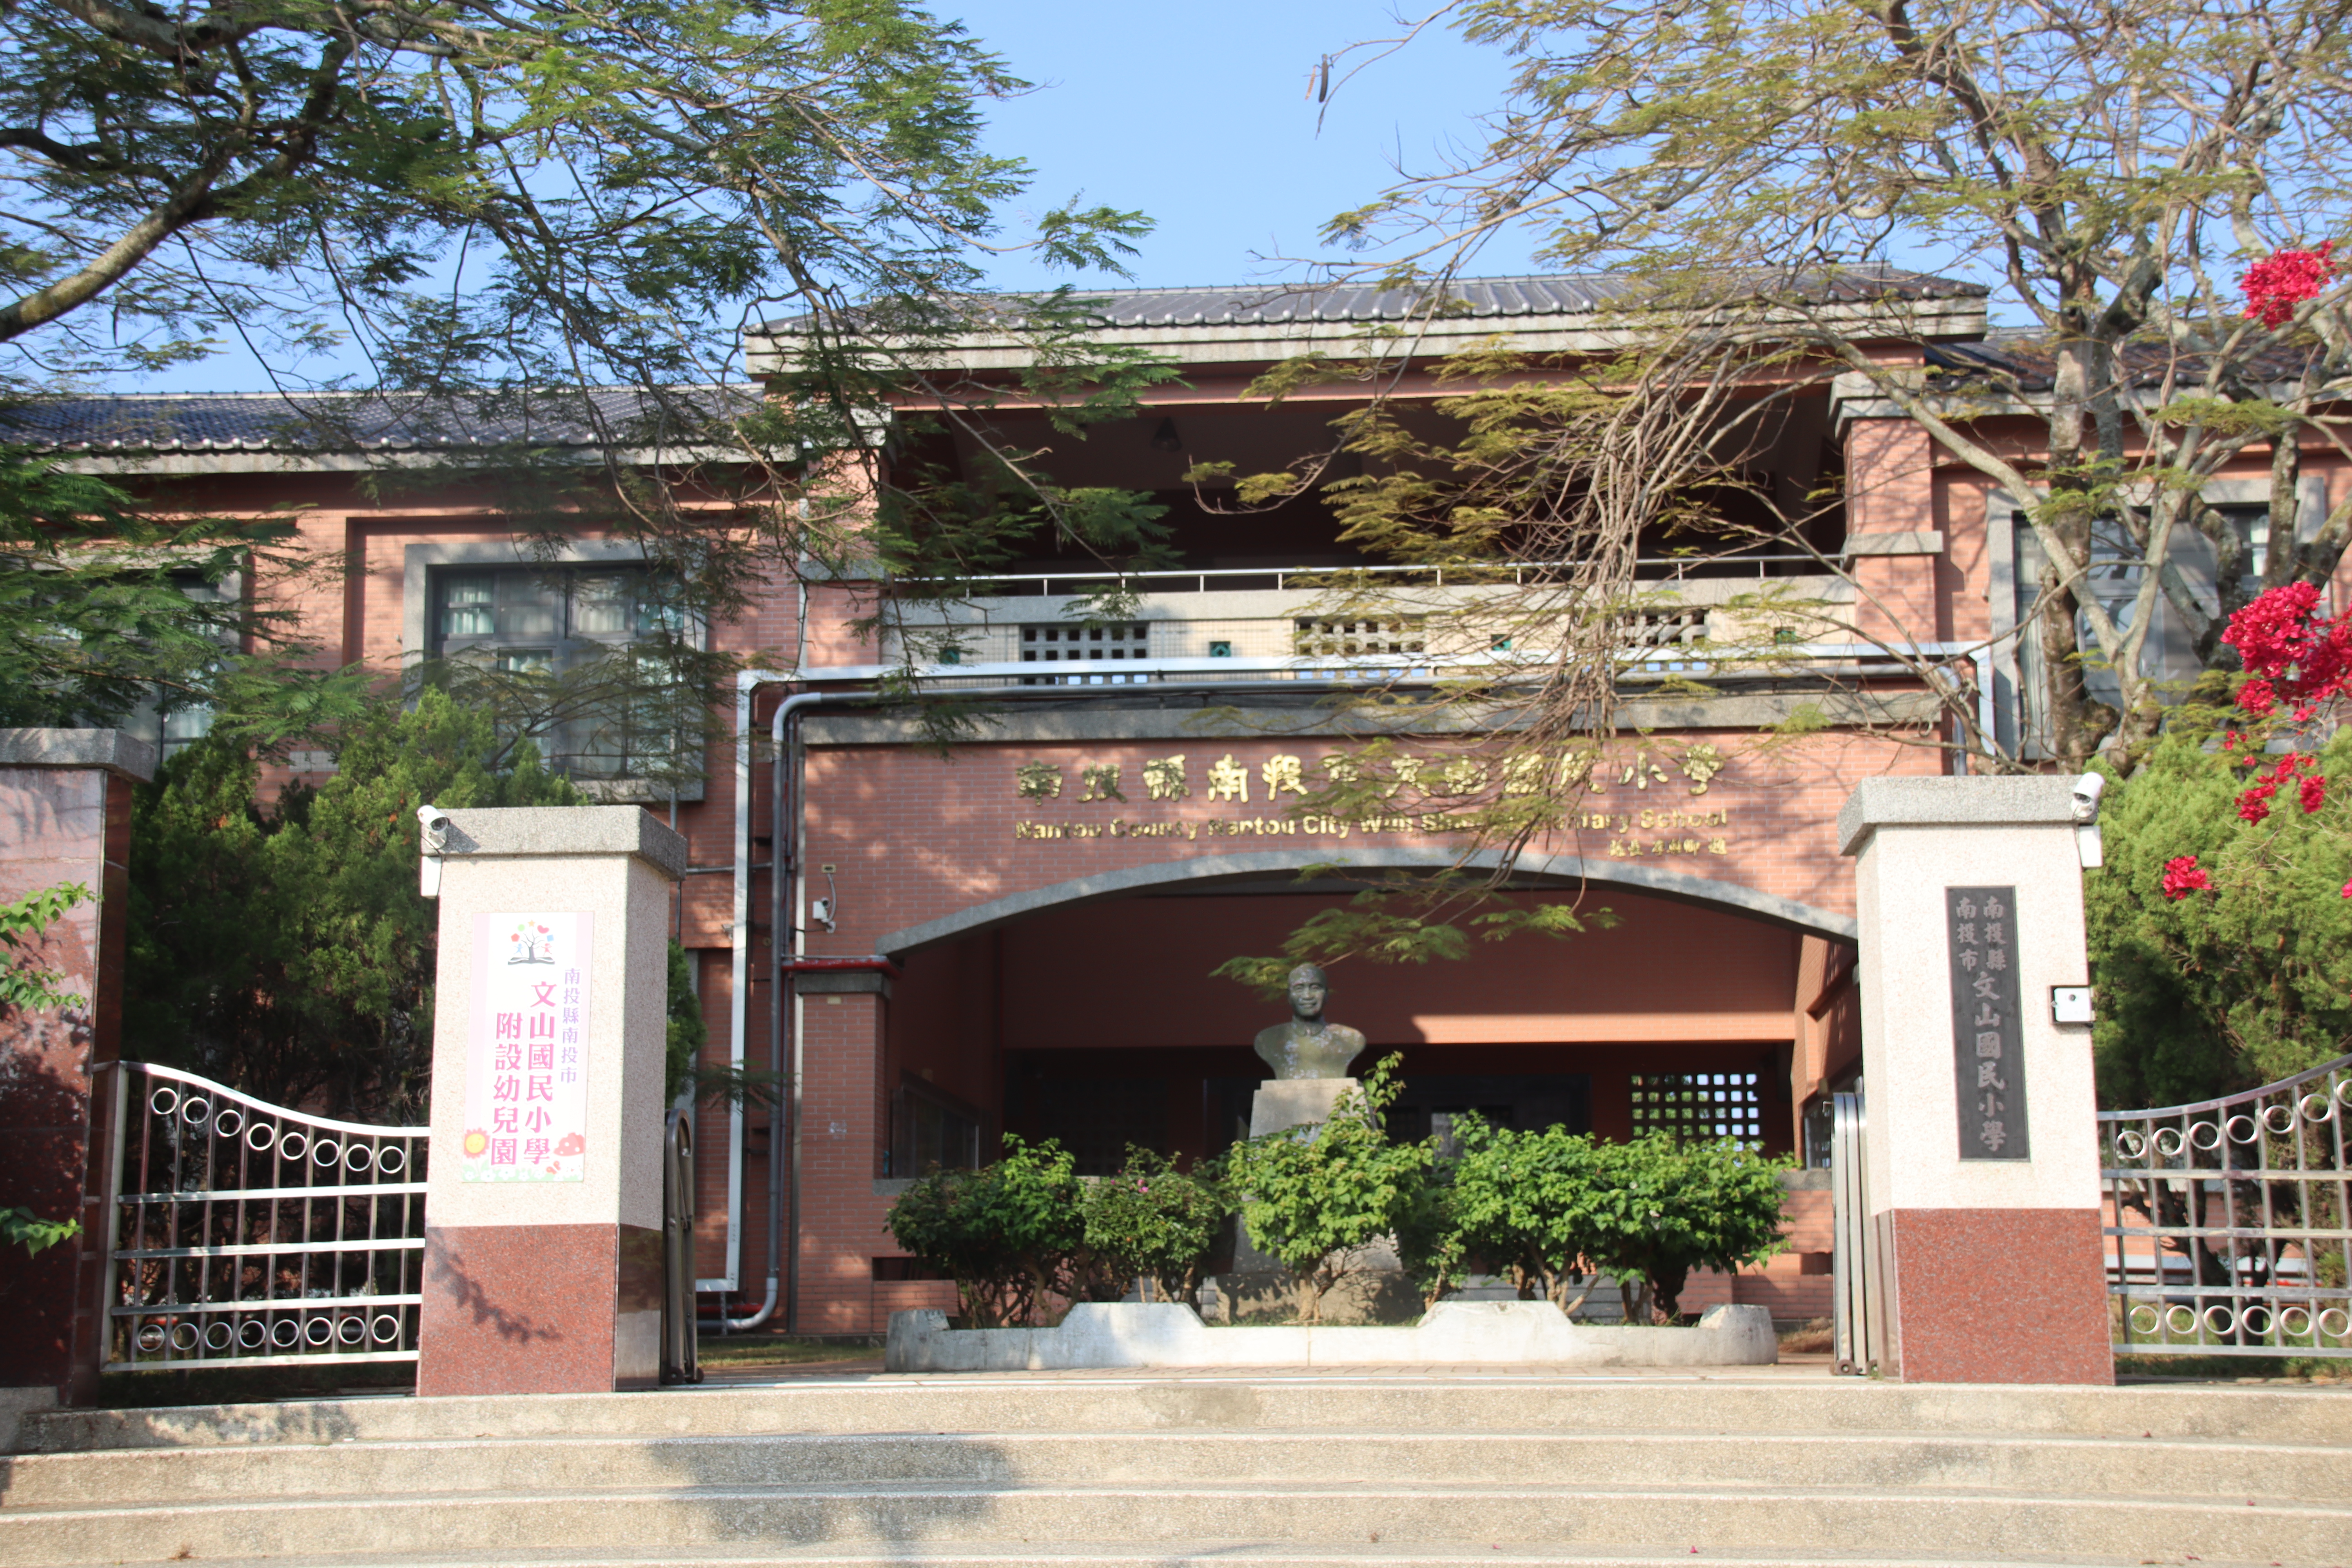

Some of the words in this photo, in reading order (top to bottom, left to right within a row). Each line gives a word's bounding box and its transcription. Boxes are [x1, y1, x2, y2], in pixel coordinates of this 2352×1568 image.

[1016, 820, 1102, 839] Nantou
[1110, 818, 1200, 841] County
[1208, 816, 1296, 836] Nantou
[1302, 815, 1351, 839] City
[1640, 808, 1727, 829] School
[1955, 897, 1979, 972] 南投市
[1982, 896, 2007, 971] 南投縣
[524, 981, 557, 1165] 文山國民小學
[561, 967, 581, 1084] 南投縣南投市
[1971, 971, 2007, 1152] 文山國民小學
[490, 1012, 523, 1166] 附設幼兒園
